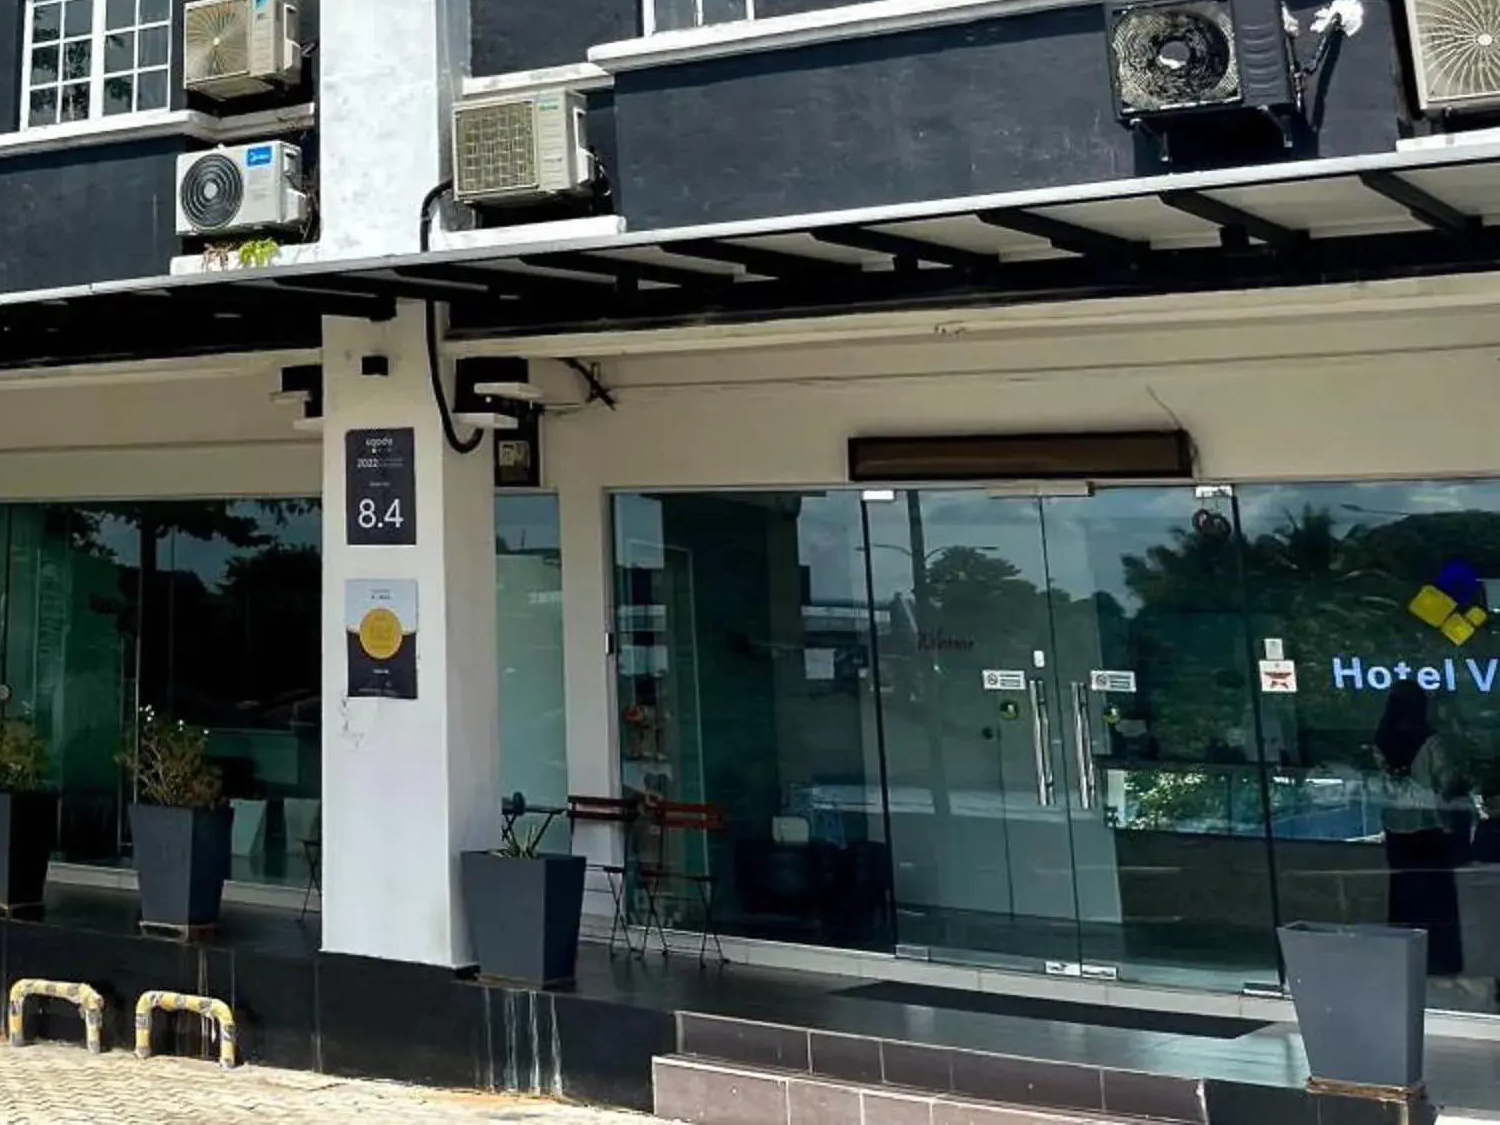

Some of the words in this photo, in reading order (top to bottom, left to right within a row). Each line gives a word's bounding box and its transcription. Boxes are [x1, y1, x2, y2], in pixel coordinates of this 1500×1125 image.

[357, 457, 379, 468] 2022
[358, 498, 404, 528] 8.4
[1332, 656, 1456, 691] Hotel
